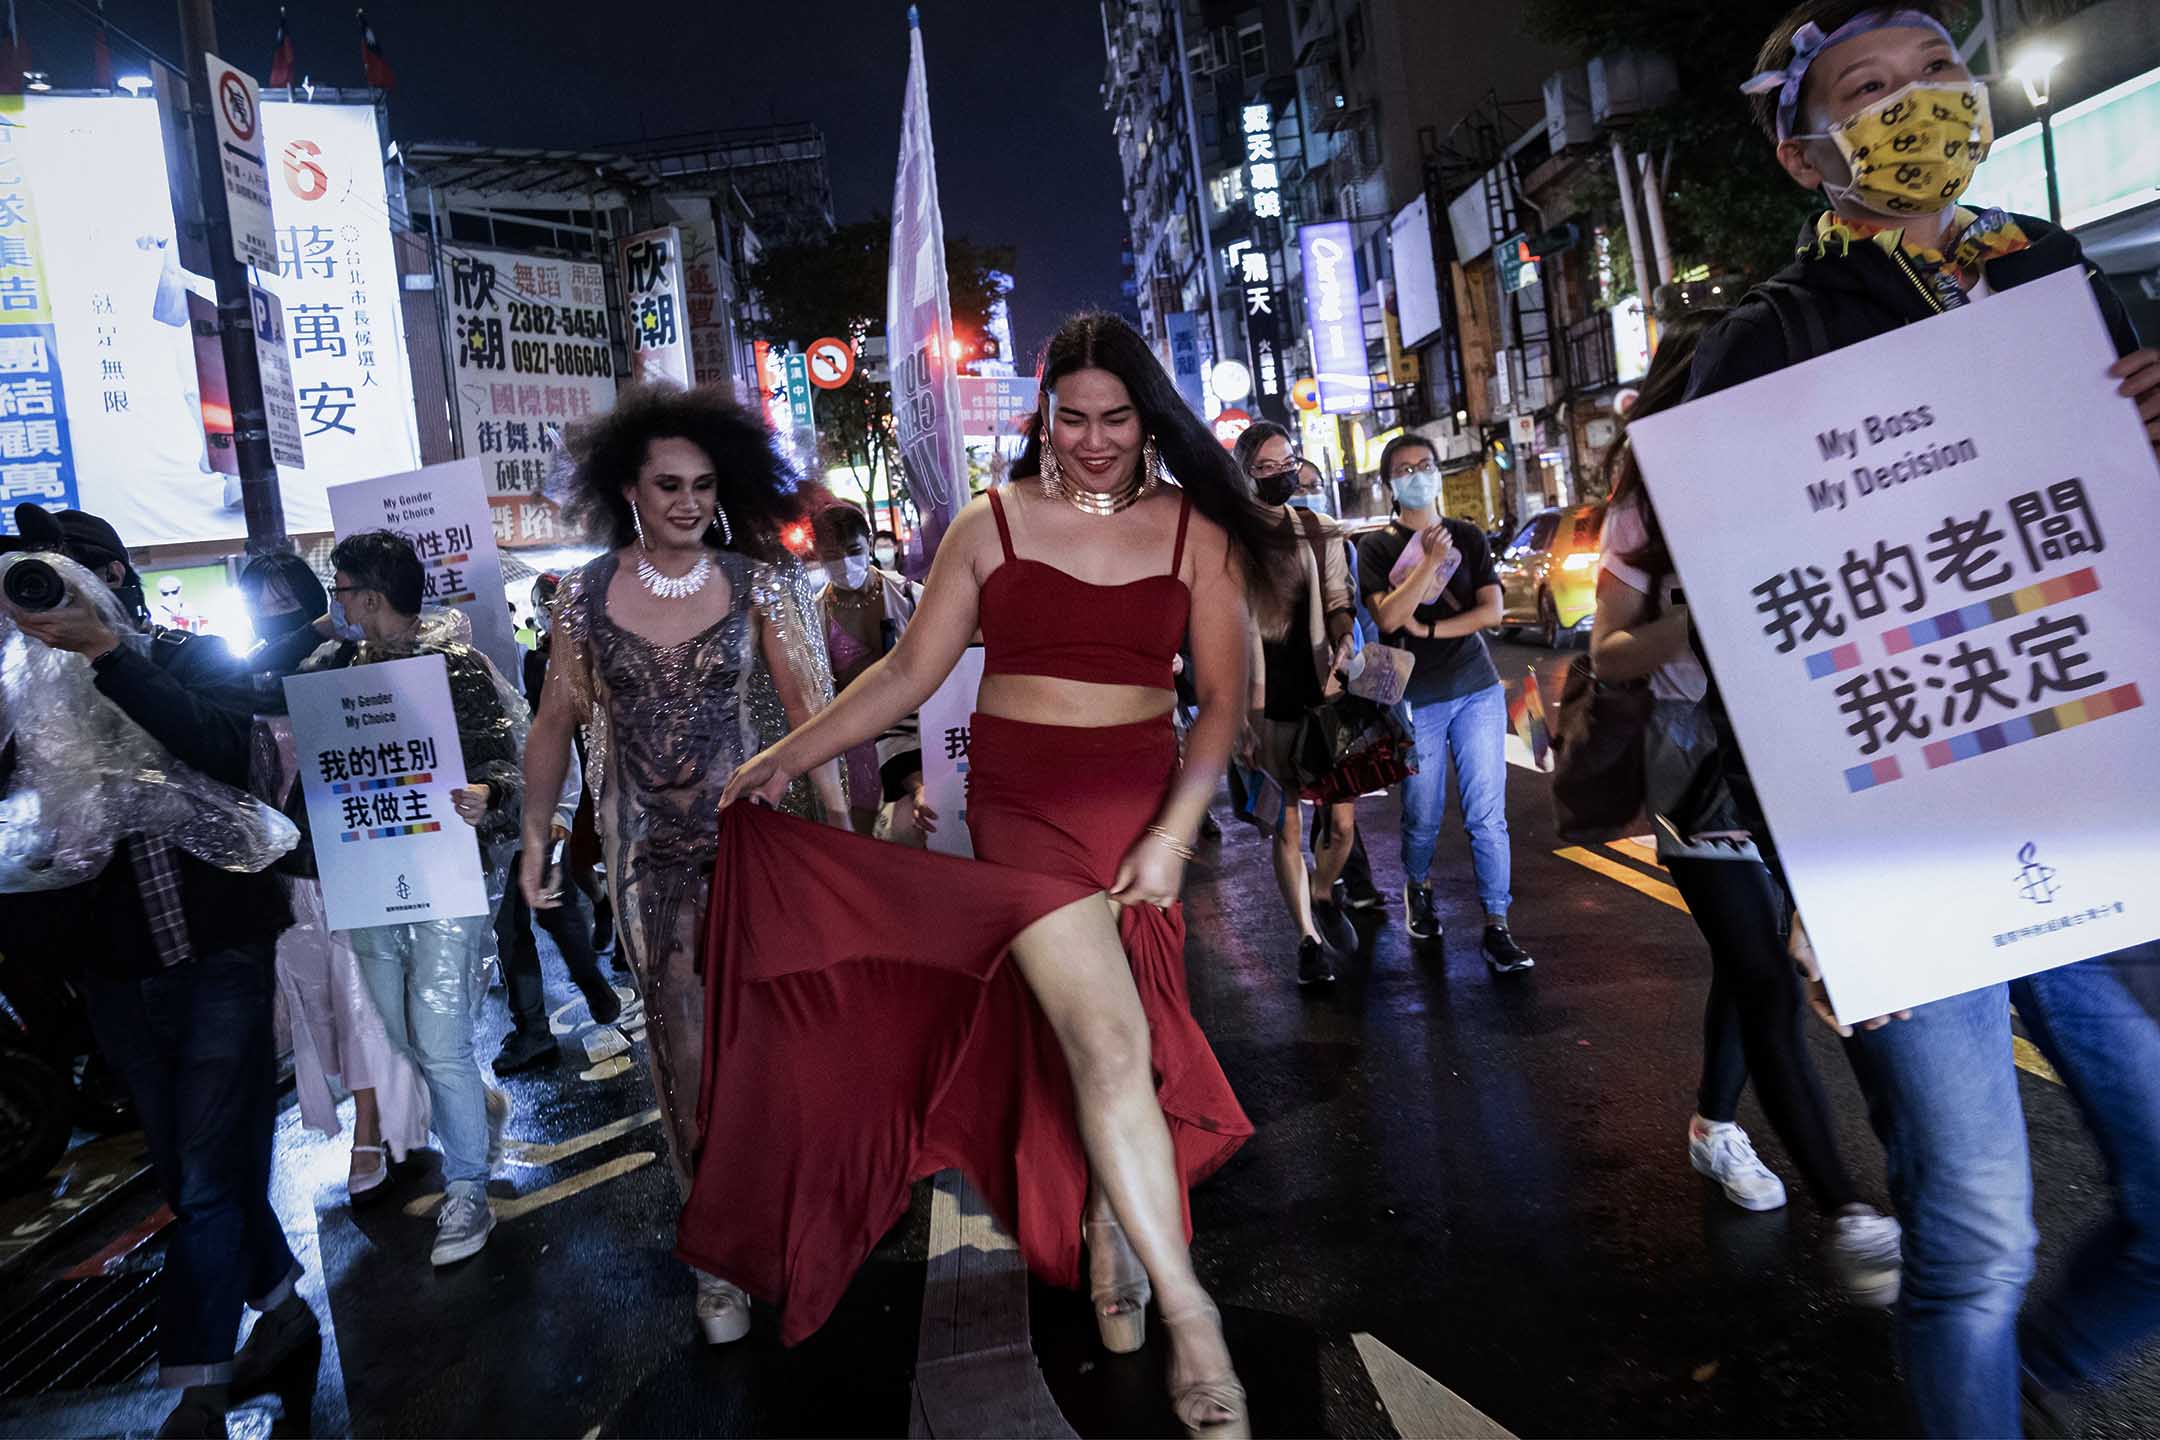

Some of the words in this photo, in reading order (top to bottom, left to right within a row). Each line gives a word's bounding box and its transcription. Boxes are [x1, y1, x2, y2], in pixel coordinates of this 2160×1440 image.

[281, 138, 329, 201] 6
[452, 257, 506, 371] 欣潮
[508, 301, 608, 339] 2382-5454
[626, 240, 677, 352] 欣潮
[274, 224, 357, 437] 蔣萬安
[511, 340, 612, 378] 0927-886648
[0, 336, 68, 532] 團結顧萬
[1816, 428, 1858, 461] My
[1863, 403, 1936, 446] Boss
[1806, 478, 1849, 512] My
[1853, 437, 1979, 497] Decision
[383, 498, 398, 512] My
[400, 491, 433, 505] Gender
[386, 511, 401, 525] My
[402, 506, 435, 521] Choice
[411, 523, 473, 560] 性別
[1751, 477, 2106, 654] 我的老闆
[341, 696, 356, 712] My
[357, 692, 394, 707] Gender
[1834, 613, 2108, 756] 我決定
[345, 715, 360, 730] My
[362, 710, 397, 726] Choice
[318, 737, 438, 783] 我的性別
[342, 789, 432, 829] 我做主
